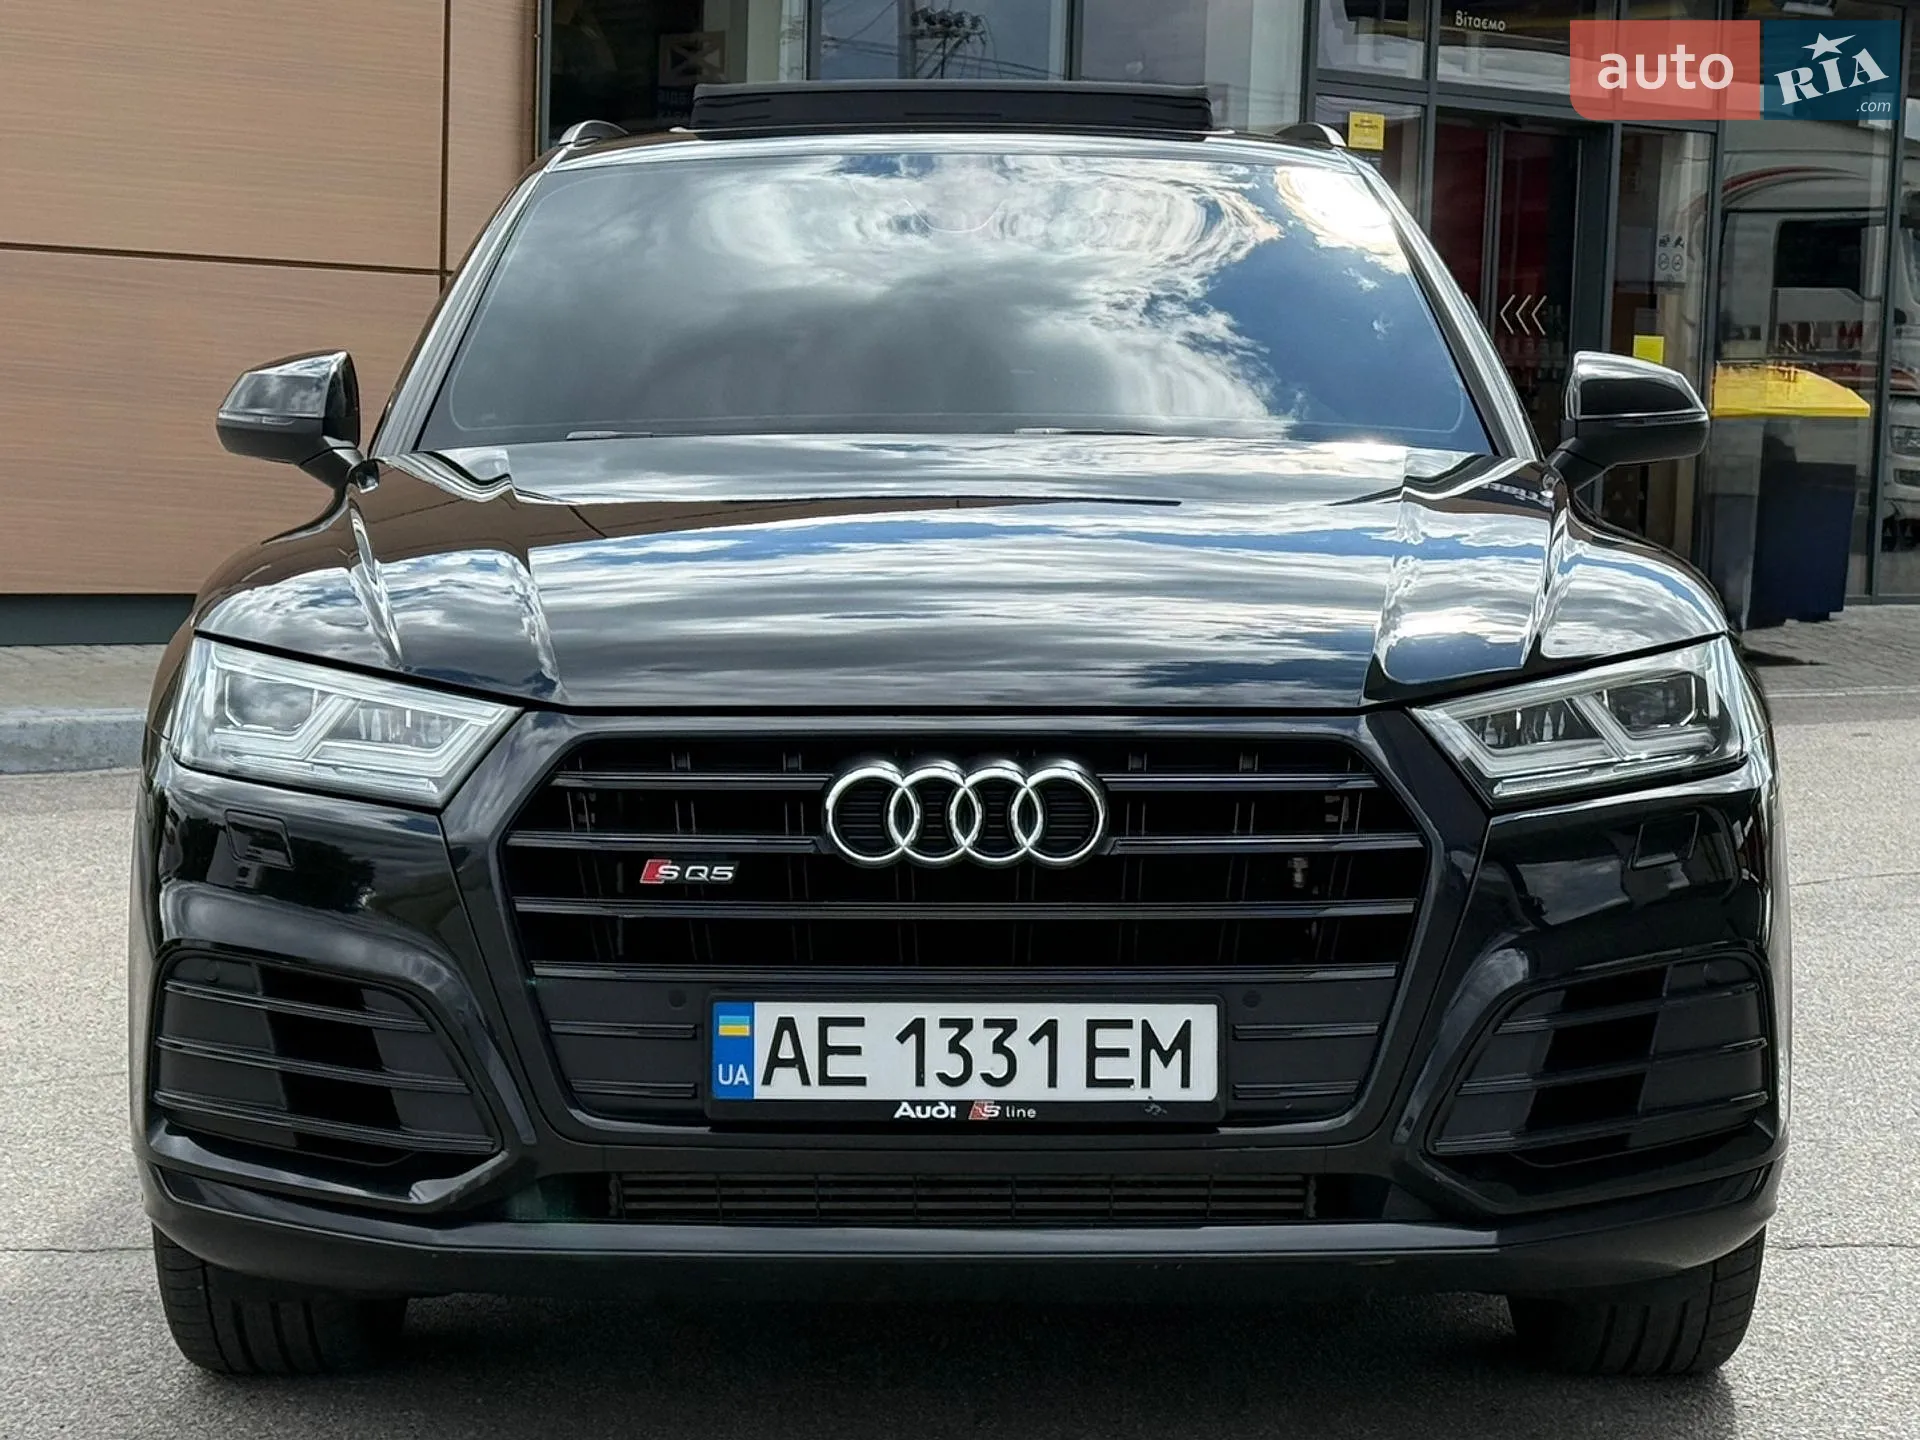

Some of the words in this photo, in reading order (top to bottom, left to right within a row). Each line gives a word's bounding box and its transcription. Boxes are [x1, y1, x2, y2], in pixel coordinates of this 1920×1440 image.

[1455, 10, 1507, 32] Вітаємо
[654, 864, 735, 882] SQ5
[761, 1015, 868, 1087] AE
[895, 1016, 1059, 1088] 1331
[1086, 1018, 1192, 1089] EM
[718, 1064, 750, 1085] UA
[893, 1101, 957, 1119] Audi
[1006, 1105, 1037, 1118] line
